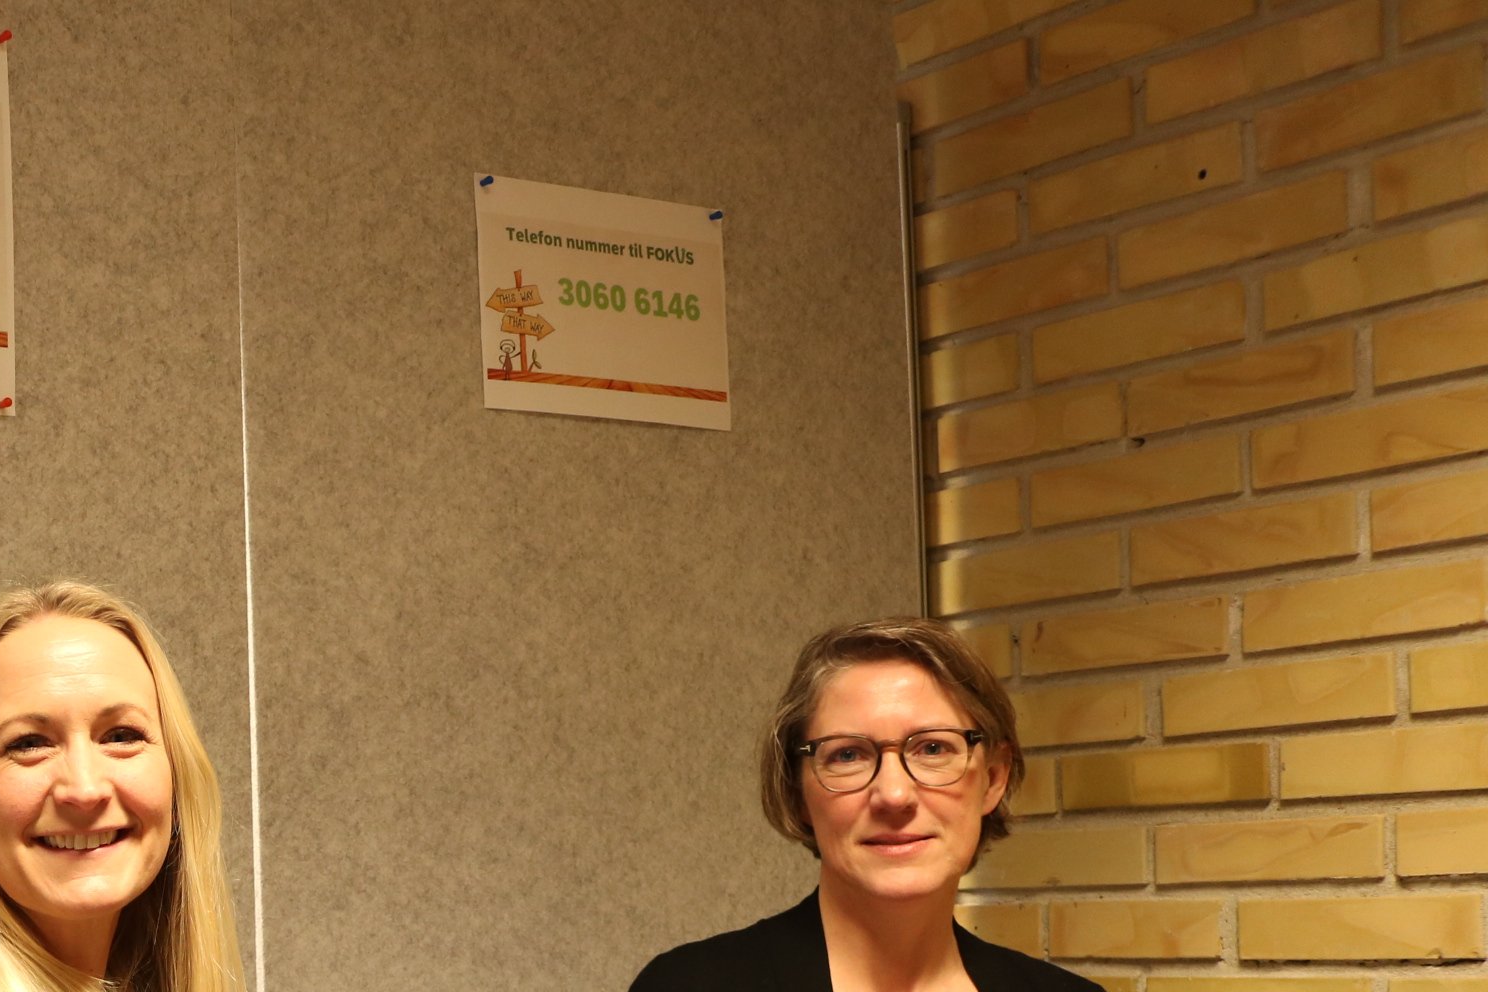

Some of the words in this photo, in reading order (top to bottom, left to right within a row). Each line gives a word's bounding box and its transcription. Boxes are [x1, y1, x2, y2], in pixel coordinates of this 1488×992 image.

[506, 227, 562, 247] Telefon
[567, 237, 625, 256] nummer
[629, 243, 643, 258] til
[646, 246, 694, 265] FOKUS
[496, 293, 516, 304] THIS
[520, 290, 533, 301] WAY
[558, 277, 626, 312] 3060
[634, 288, 700, 321] 6146
[507, 315, 526, 328] THAT
[530, 321, 544, 334] WAY
